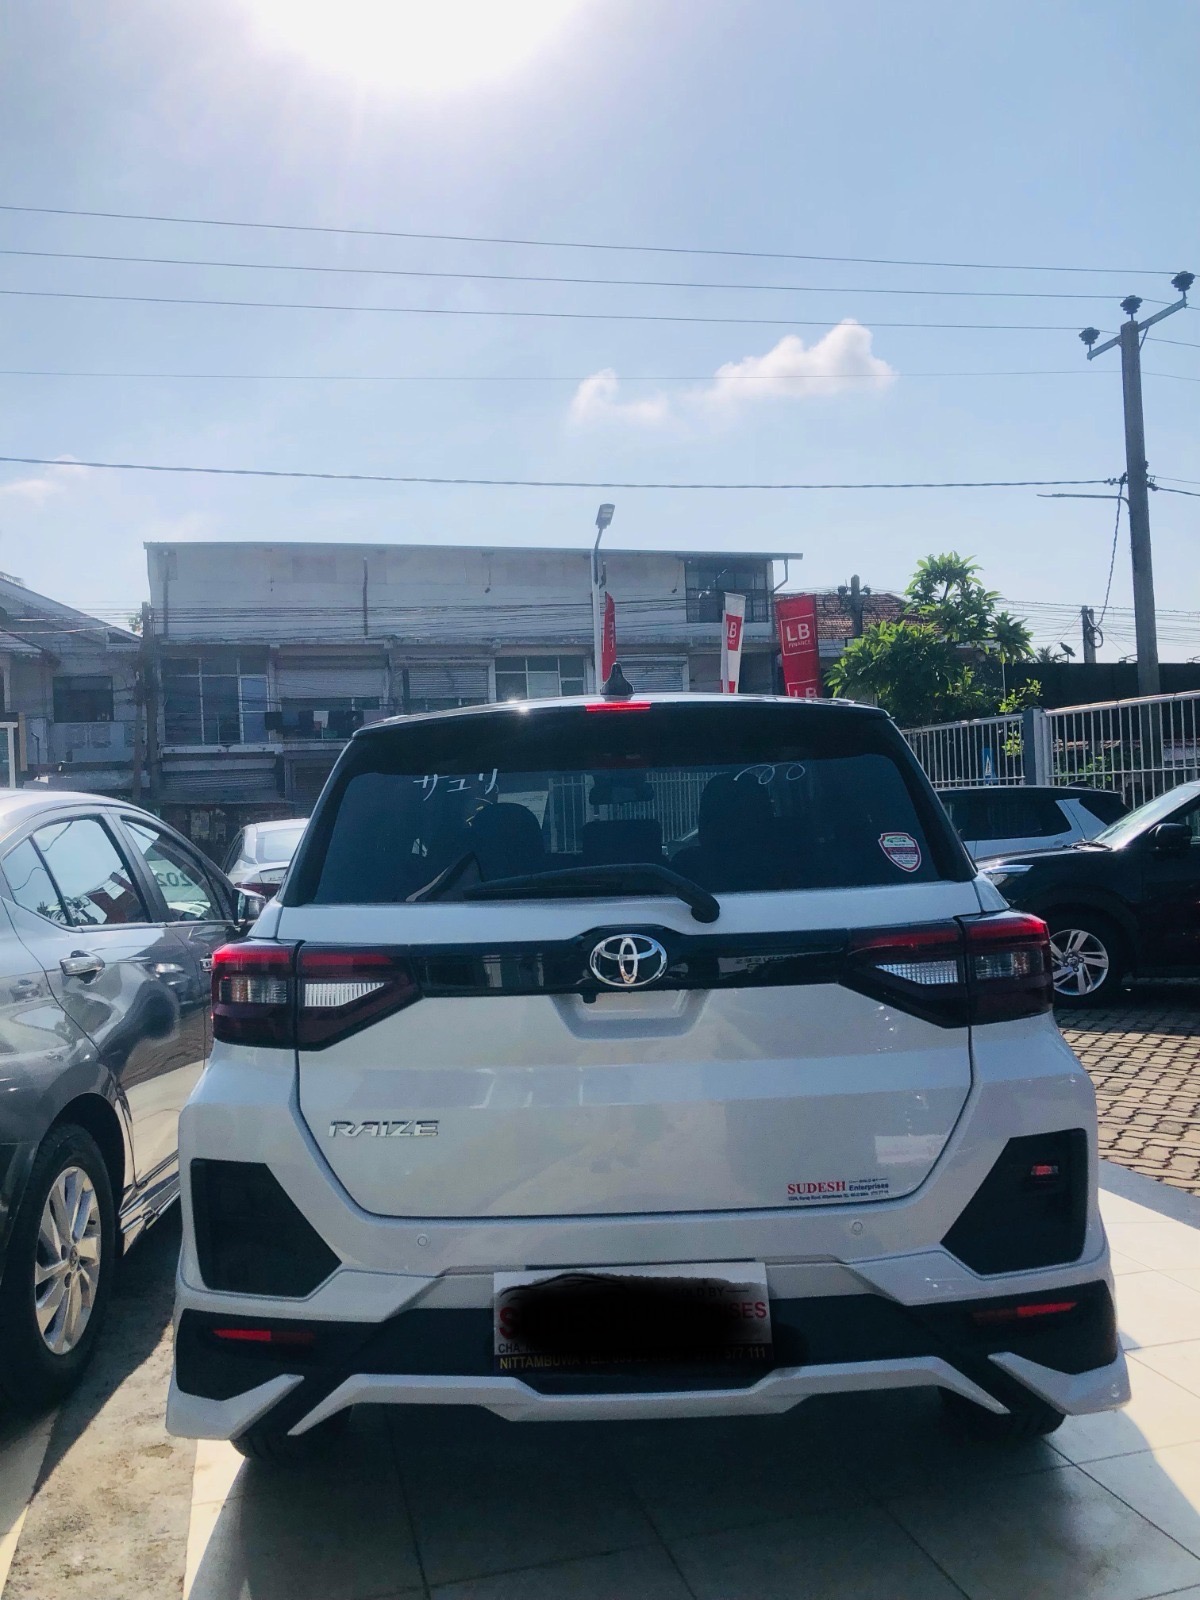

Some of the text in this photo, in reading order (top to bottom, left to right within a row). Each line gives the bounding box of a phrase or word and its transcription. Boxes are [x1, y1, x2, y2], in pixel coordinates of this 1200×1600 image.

[786, 623, 810, 642] LB
[788, 640, 811, 649] FINANCE
[328, 1120, 439, 1137] RAIZE
[787, 1181, 846, 1195] SUDESH
[848, 1183, 889, 1192] Enterprises
